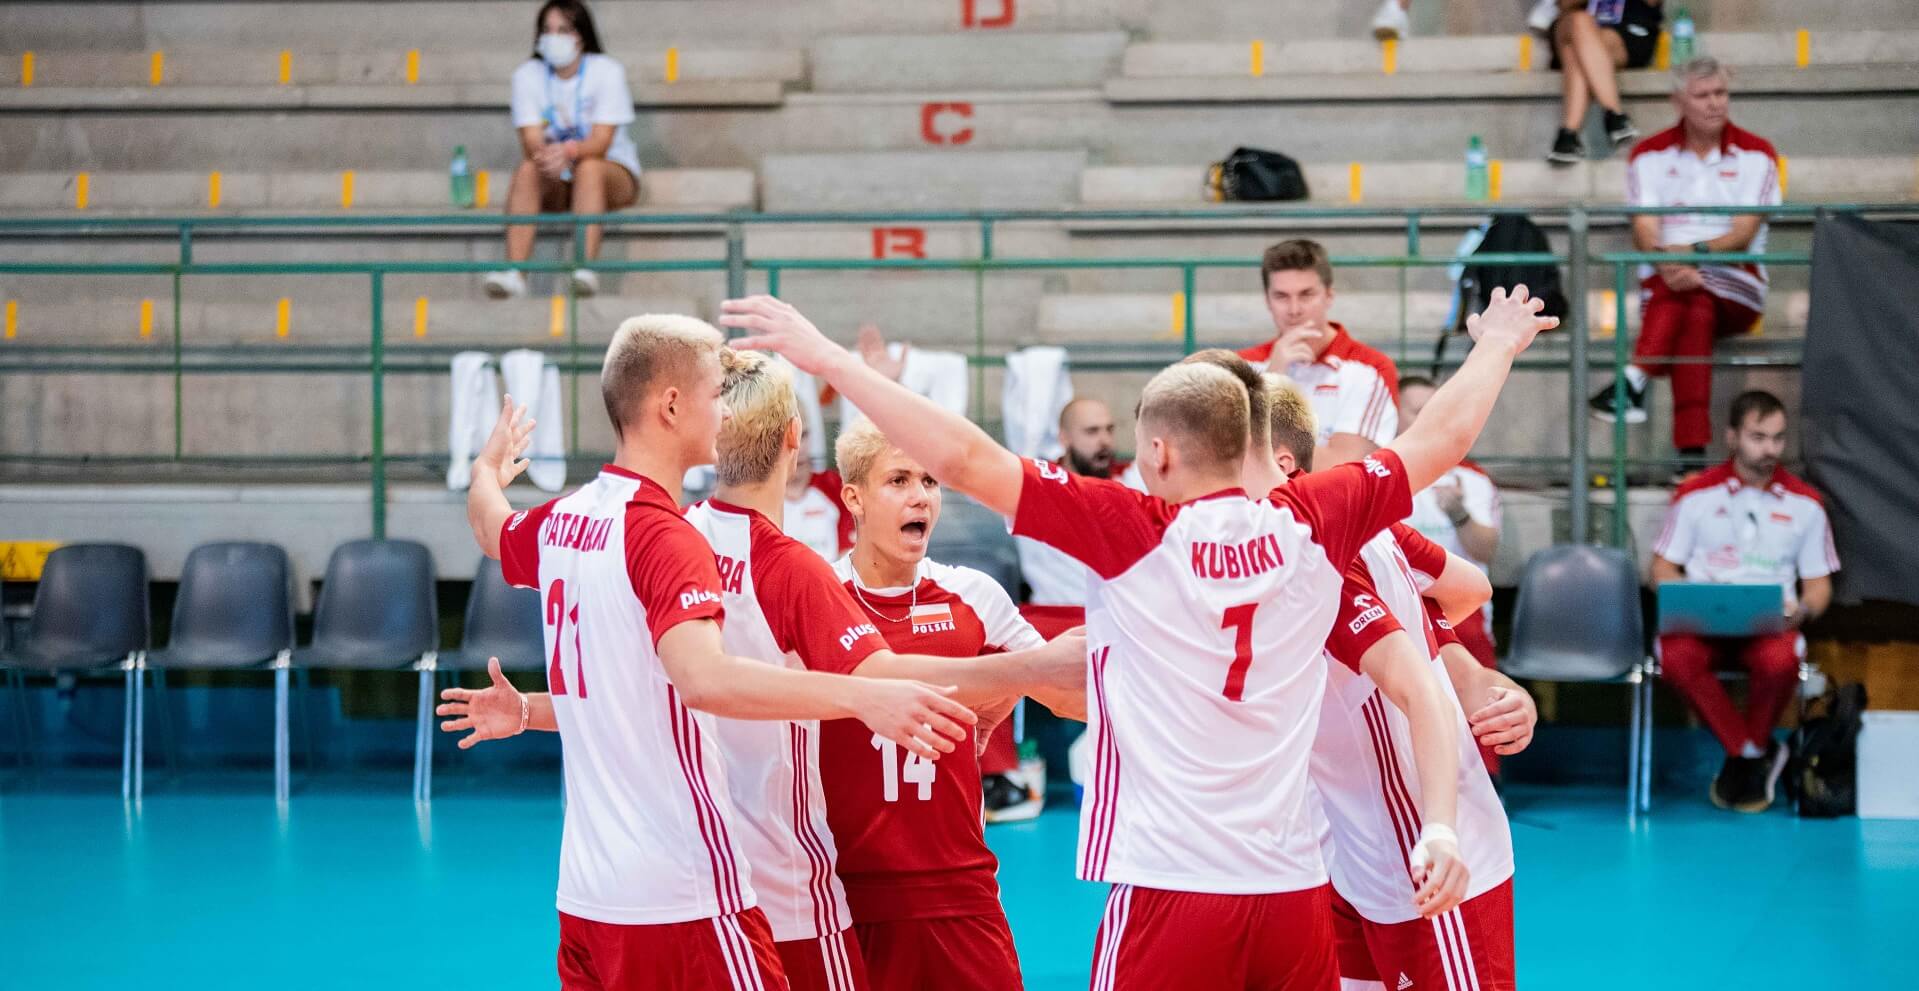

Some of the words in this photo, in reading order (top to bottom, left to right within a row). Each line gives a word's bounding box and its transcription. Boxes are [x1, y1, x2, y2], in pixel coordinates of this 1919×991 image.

[961, 0, 1016, 28] D
[920, 101, 975, 145] C
[912, 621, 956, 635] POLSKA
[1351, 606, 1384, 631] ORLEN
[546, 578, 588, 699] 21
[839, 623, 877, 651] plus
[870, 723, 937, 802] 14
